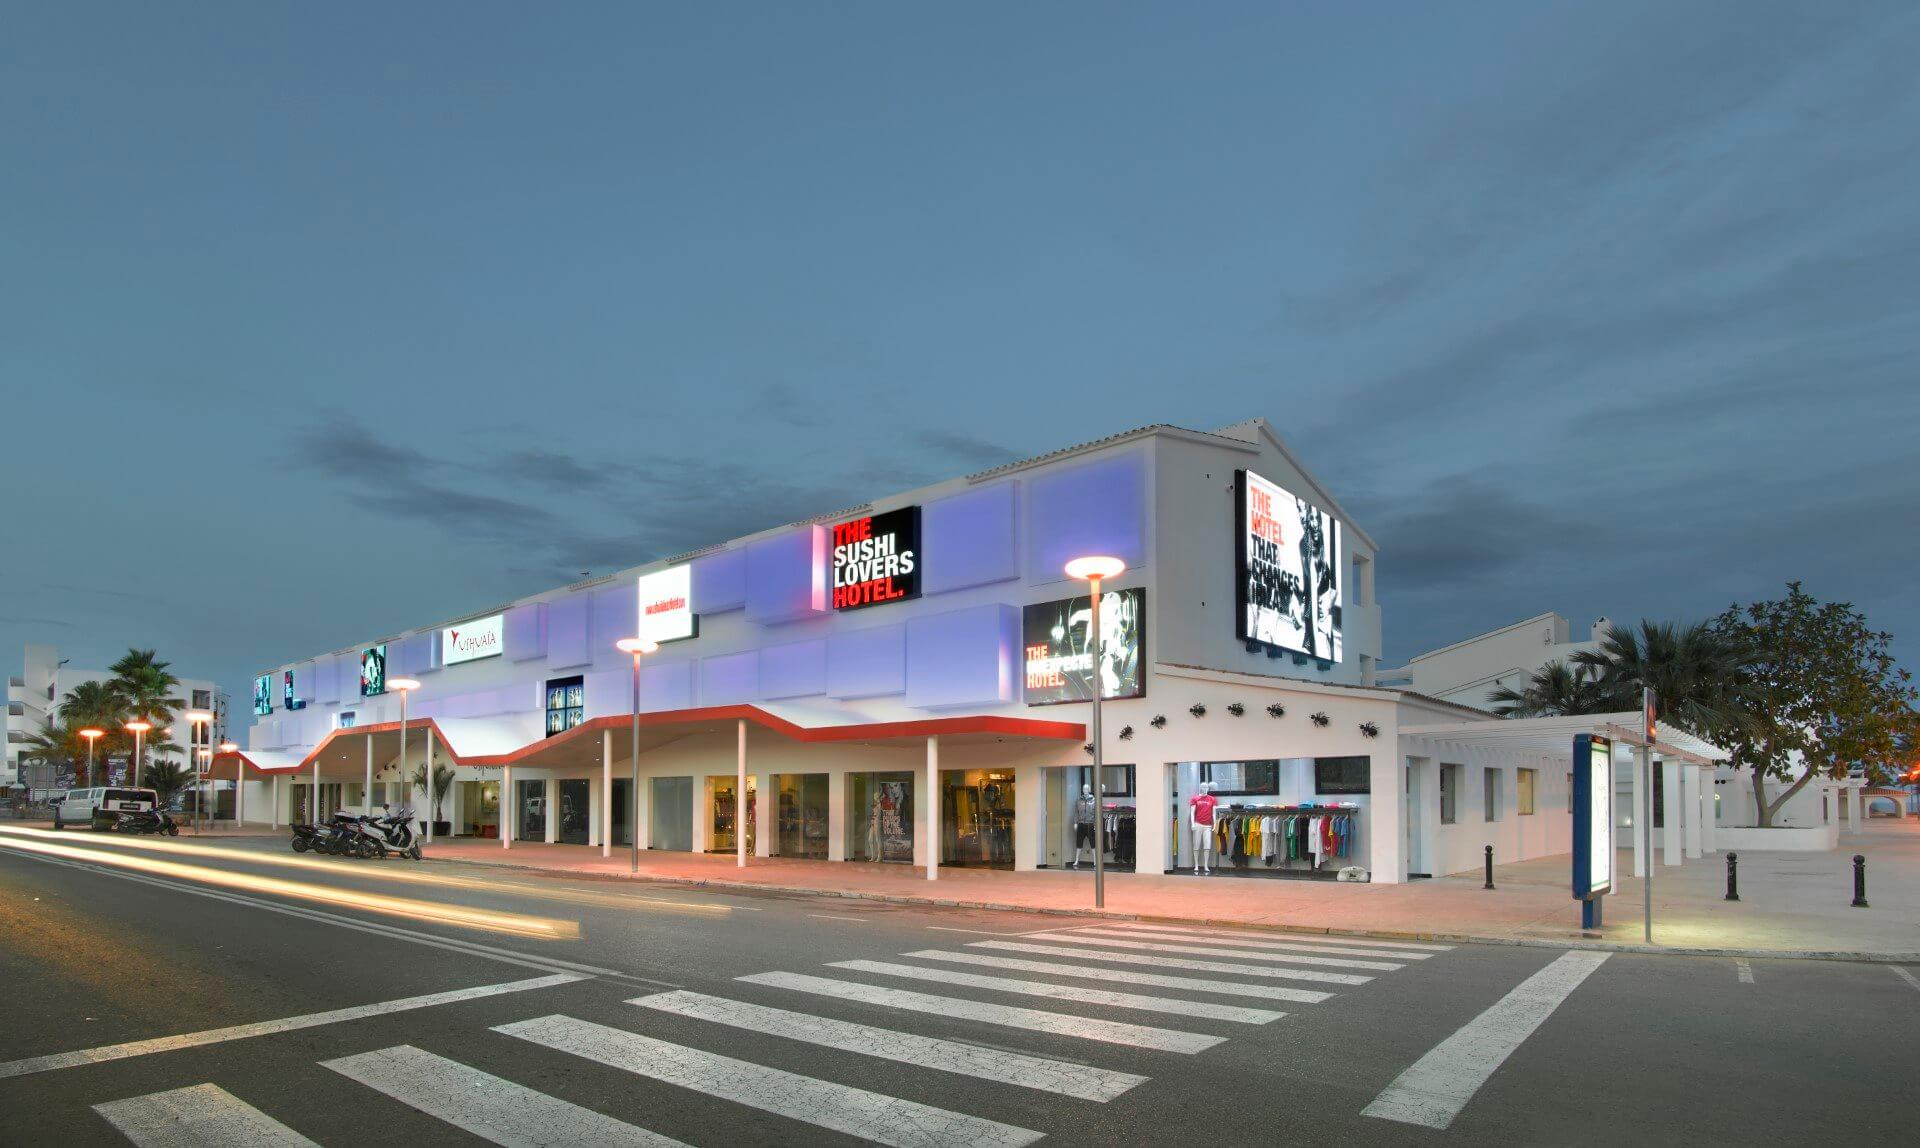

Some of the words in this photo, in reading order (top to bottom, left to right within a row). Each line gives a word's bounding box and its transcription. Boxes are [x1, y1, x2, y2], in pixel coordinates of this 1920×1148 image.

[1250, 486, 1272, 516] THE
[834, 516, 871, 547] THE
[1251, 510, 1285, 545] HOTEL
[834, 532, 896, 567] SUSHI
[1251, 533, 1278, 564] THAT
[834, 550, 914, 588] LOVERS
[1251, 558, 1300, 594] CHANGES
[833, 576, 904, 609] HOTEL.
[1026, 644, 1049, 661] THE
[1026, 653, 1094, 675] UNEXPECTE
[1026, 671, 1066, 689] HOTEL.
